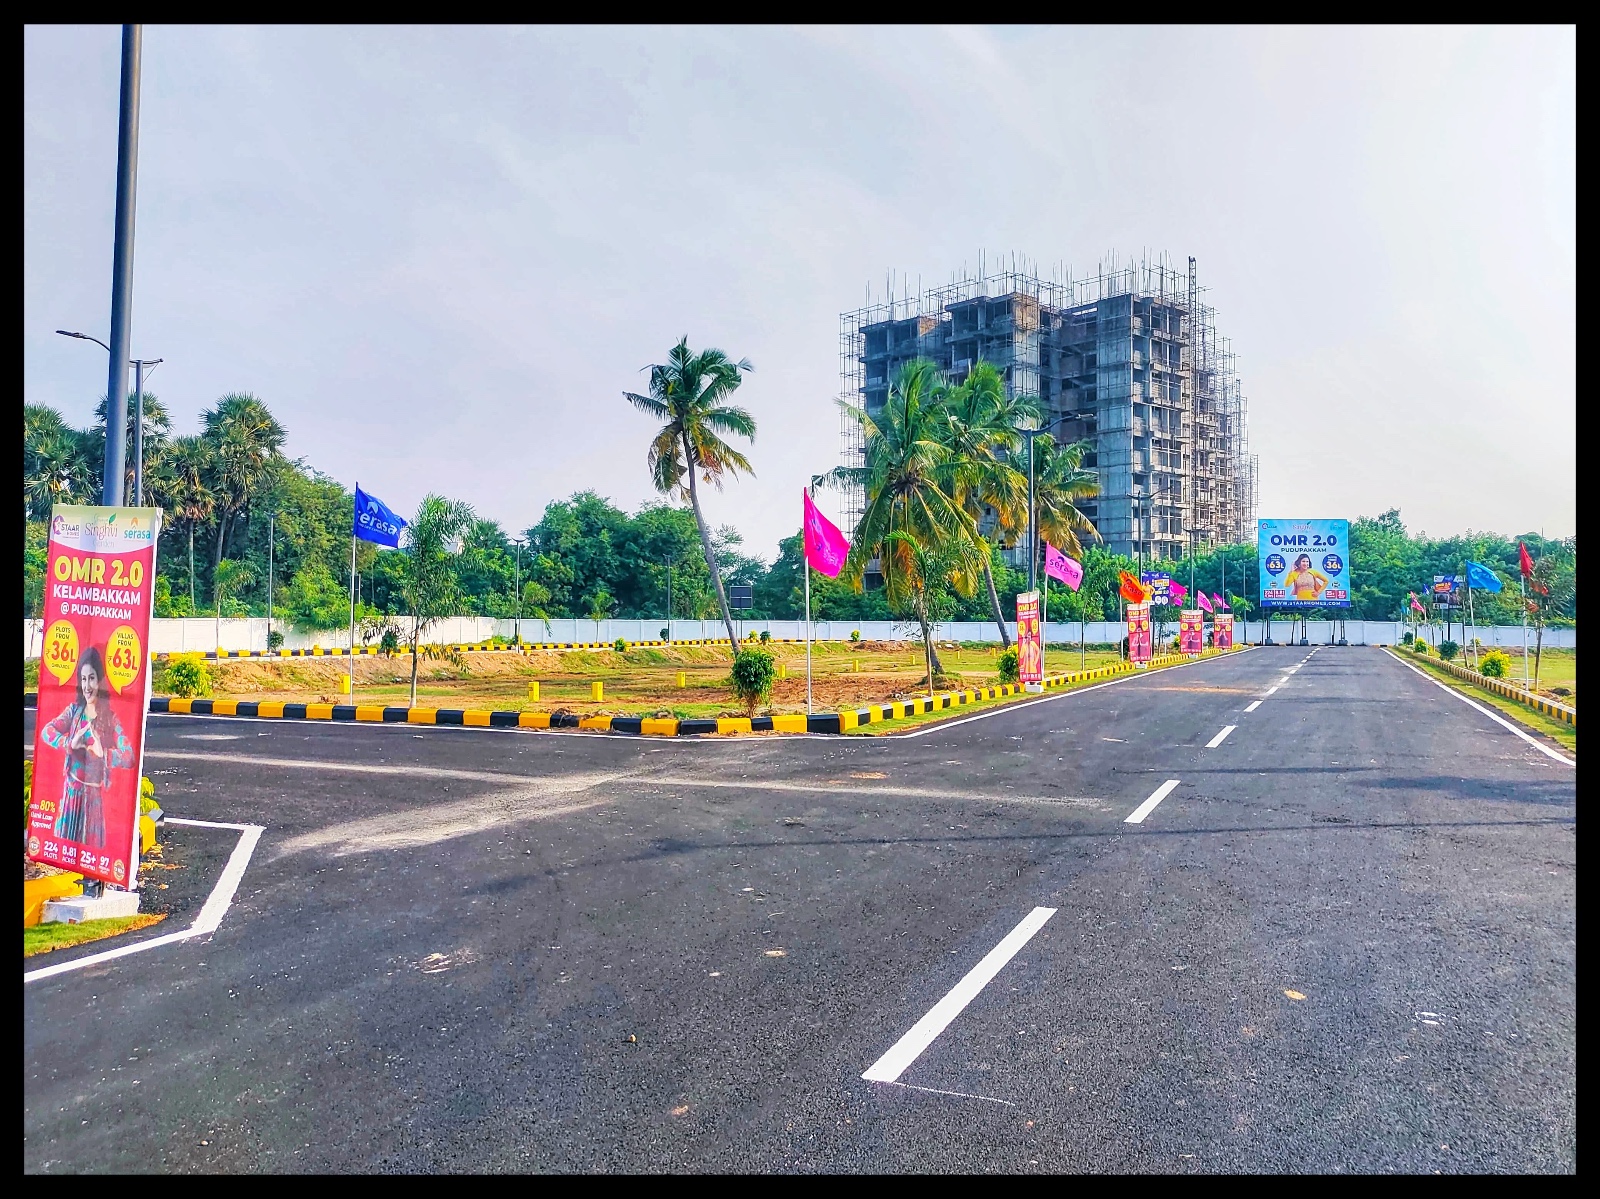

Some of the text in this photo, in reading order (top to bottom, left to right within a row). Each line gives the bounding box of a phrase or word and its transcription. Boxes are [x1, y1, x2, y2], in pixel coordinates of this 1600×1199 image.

[61, 523, 80, 532] STAAR
[84, 522, 118, 541] Singhvi
[123, 526, 151, 540] serasa
[1270, 534, 1337, 546] OMR 2.0
[54, 555, 144, 588] OMR 2.0
[53, 584, 141, 606] KELAMBAKKAM
[60, 602, 132, 620] @ PUDUPAKKAM
[55, 626, 71, 634] PLOTS
[116, 632, 134, 640] VILLAS
[40, 799, 56, 813] 80%
[43, 840, 59, 853] 224
[62, 845, 77, 858] 8.81
[43, 851, 58, 860] PLOTS
[61, 856, 76, 865] ACRES
[80, 850, 97, 864] 25+
[100, 855, 110, 868] 97
